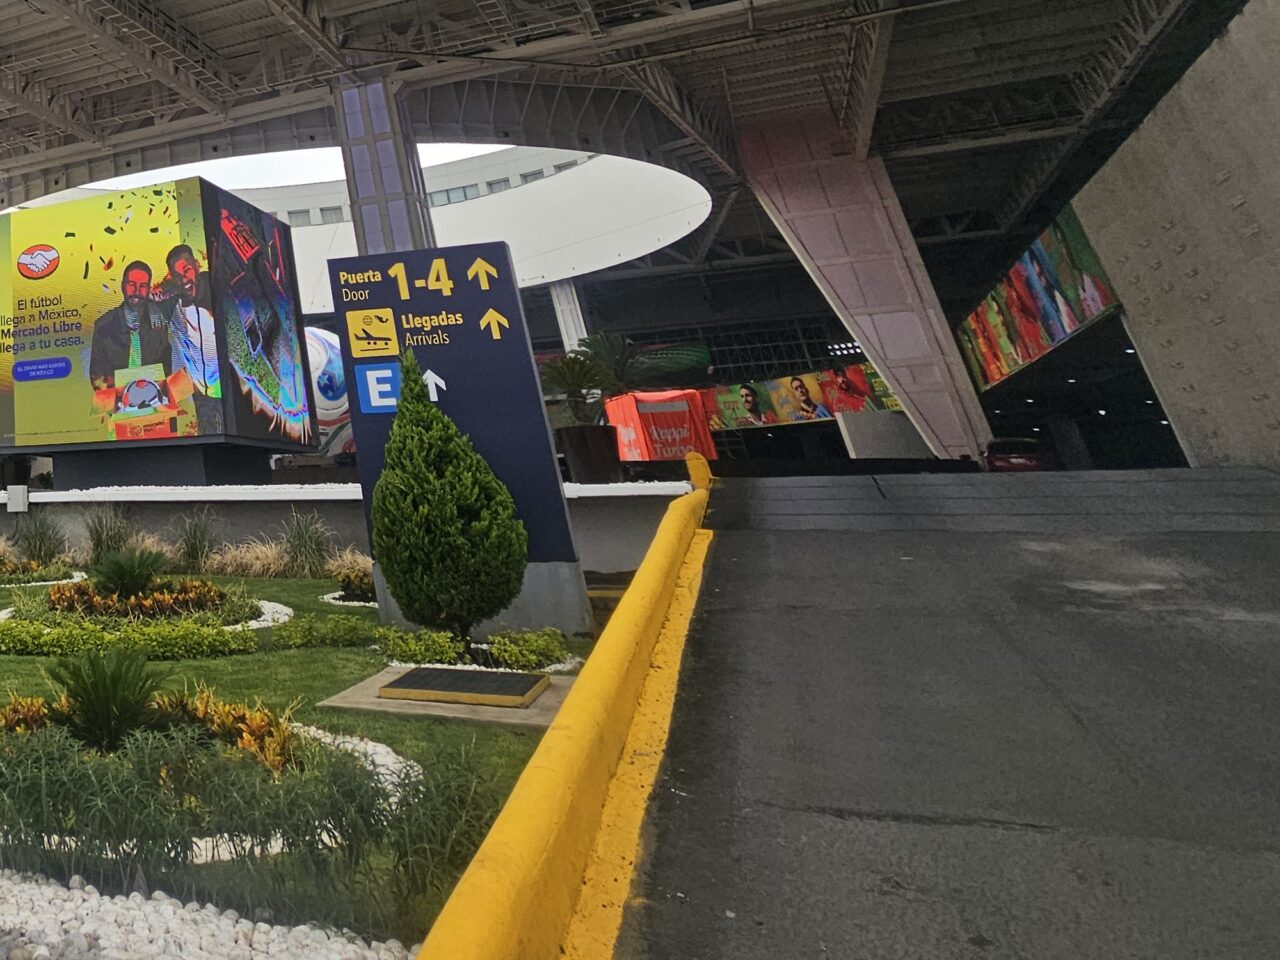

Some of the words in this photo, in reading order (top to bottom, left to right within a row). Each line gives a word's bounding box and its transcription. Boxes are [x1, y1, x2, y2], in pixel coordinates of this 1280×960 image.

[339, 269, 382, 285] Puerta
[387, 257, 454, 301] 1-4
[17, 299, 27, 311] El
[30, 294, 62, 309] fútbol
[342, 289, 370, 302] Door
[0, 315, 26, 328] llega
[401, 311, 464, 331] Llegadas
[0, 325, 50, 340] Mercado
[53, 321, 82, 334] Libre
[405, 329, 450, 347] Arrivals
[0, 342, 26, 355] llega
[28, 341, 36, 350] a
[40, 339, 51, 350] tu
[54, 336, 85, 348] casa.
[366, 369, 397, 407] E
[650, 424, 690, 442] Rappi
